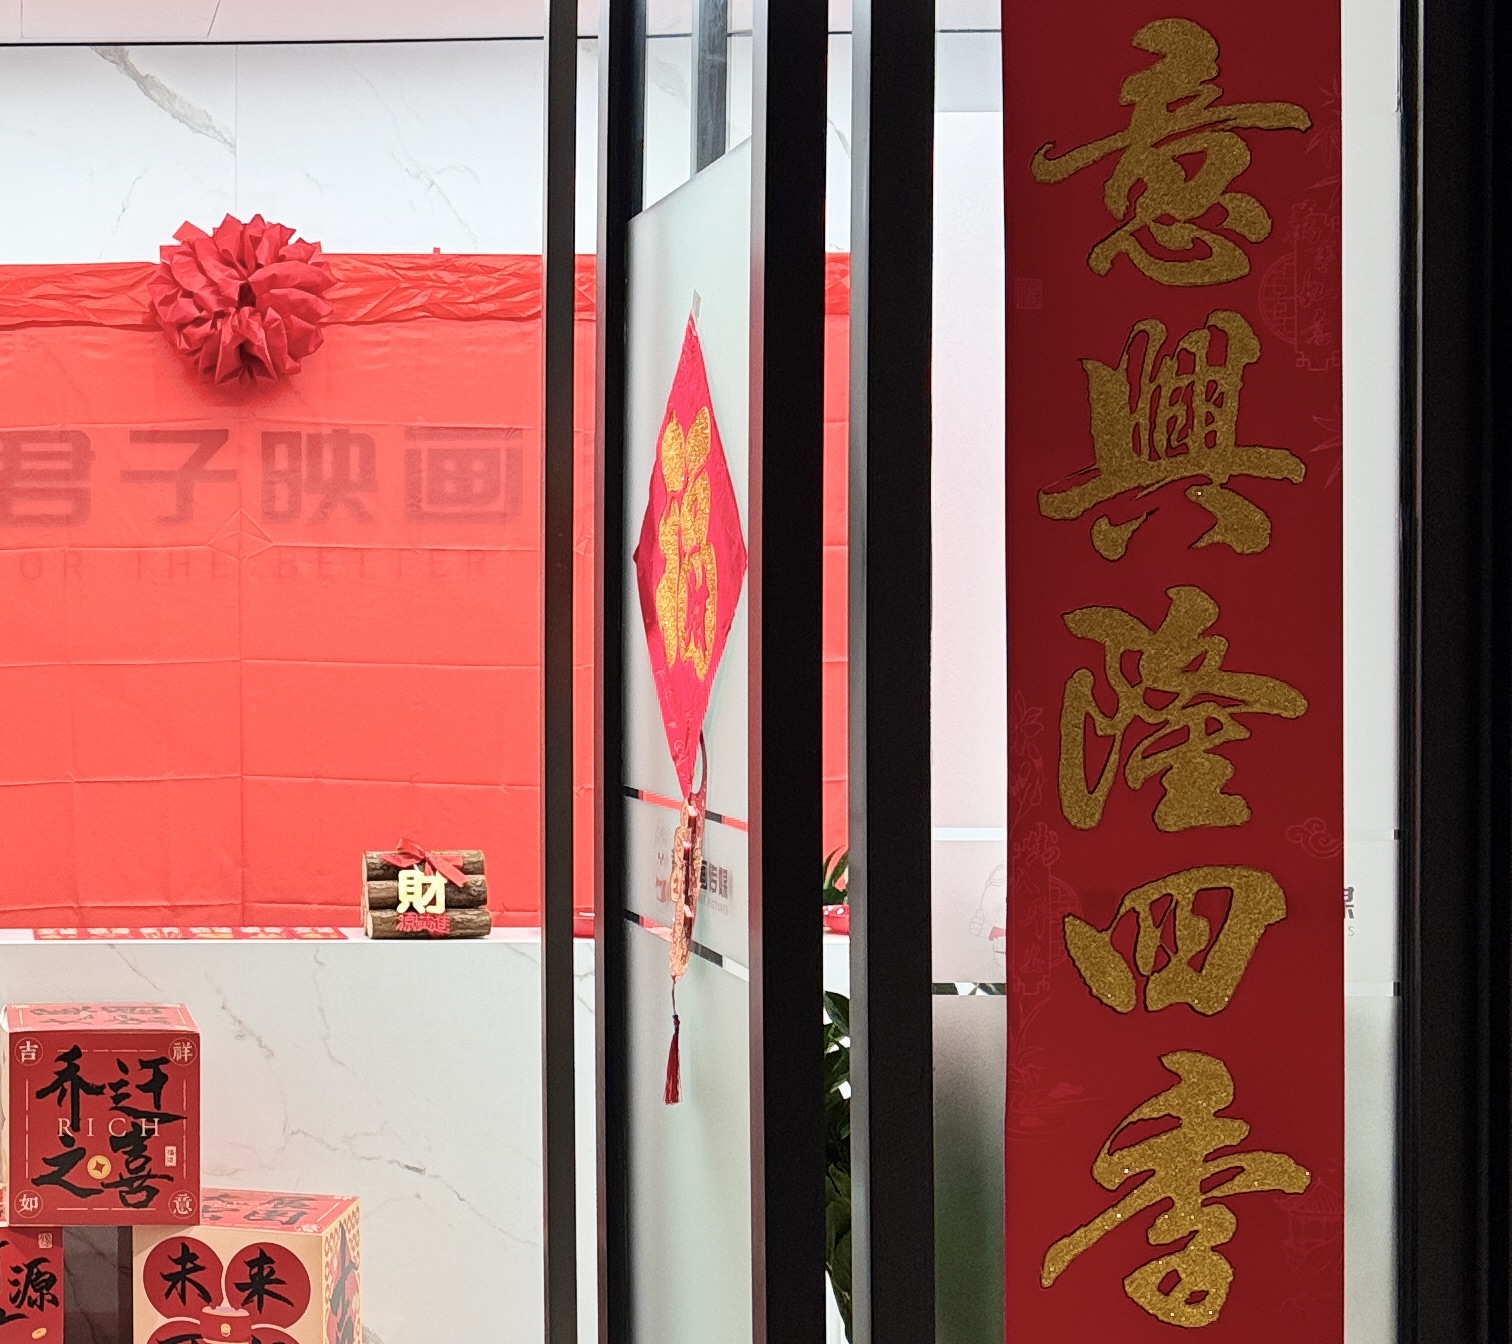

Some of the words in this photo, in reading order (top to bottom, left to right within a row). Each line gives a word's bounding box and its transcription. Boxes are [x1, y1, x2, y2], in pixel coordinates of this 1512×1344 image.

[19, 1040, 39, 1063] 吉
[172, 1041, 193, 1063] 祥
[57, 1117, 161, 1137] RICH
[19, 1193, 39, 1212] 如
